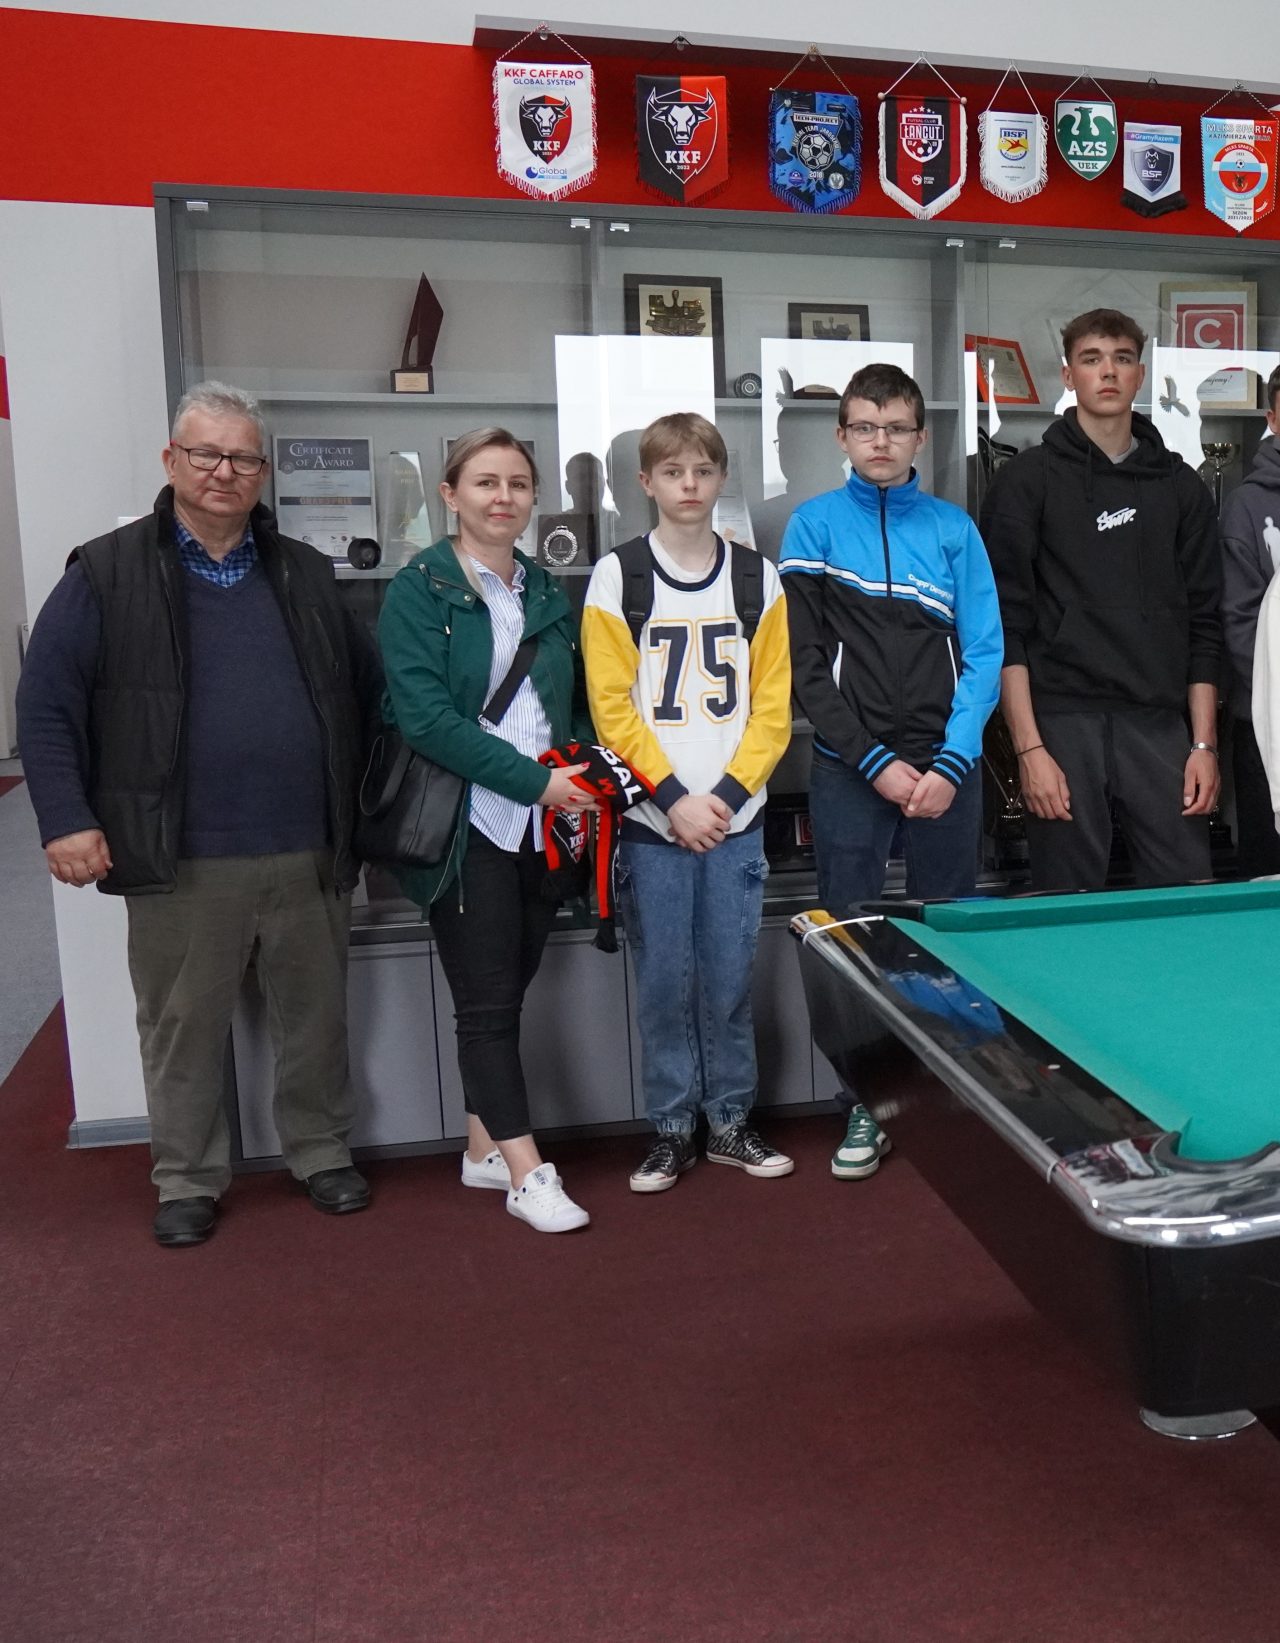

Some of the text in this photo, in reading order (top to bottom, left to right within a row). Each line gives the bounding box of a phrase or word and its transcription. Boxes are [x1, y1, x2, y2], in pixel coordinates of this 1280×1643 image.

[504, 68, 584, 79] KKF CAFFARO
[1003, 130, 1025, 138] BSF
[533, 140, 561, 151] KKF
[1067, 140, 1108, 157] AZS
[664, 150, 701, 164] KKF
[538, 167, 568, 175] Global
[1078, 162, 1099, 170] UEK
[1141, 169, 1162, 178] BSF
[1193, 318, 1222, 349] C
[289, 442, 353, 457] CERTIFICATE
[295, 455, 354, 469] OF AWARD
[648, 617, 740, 727] 75
